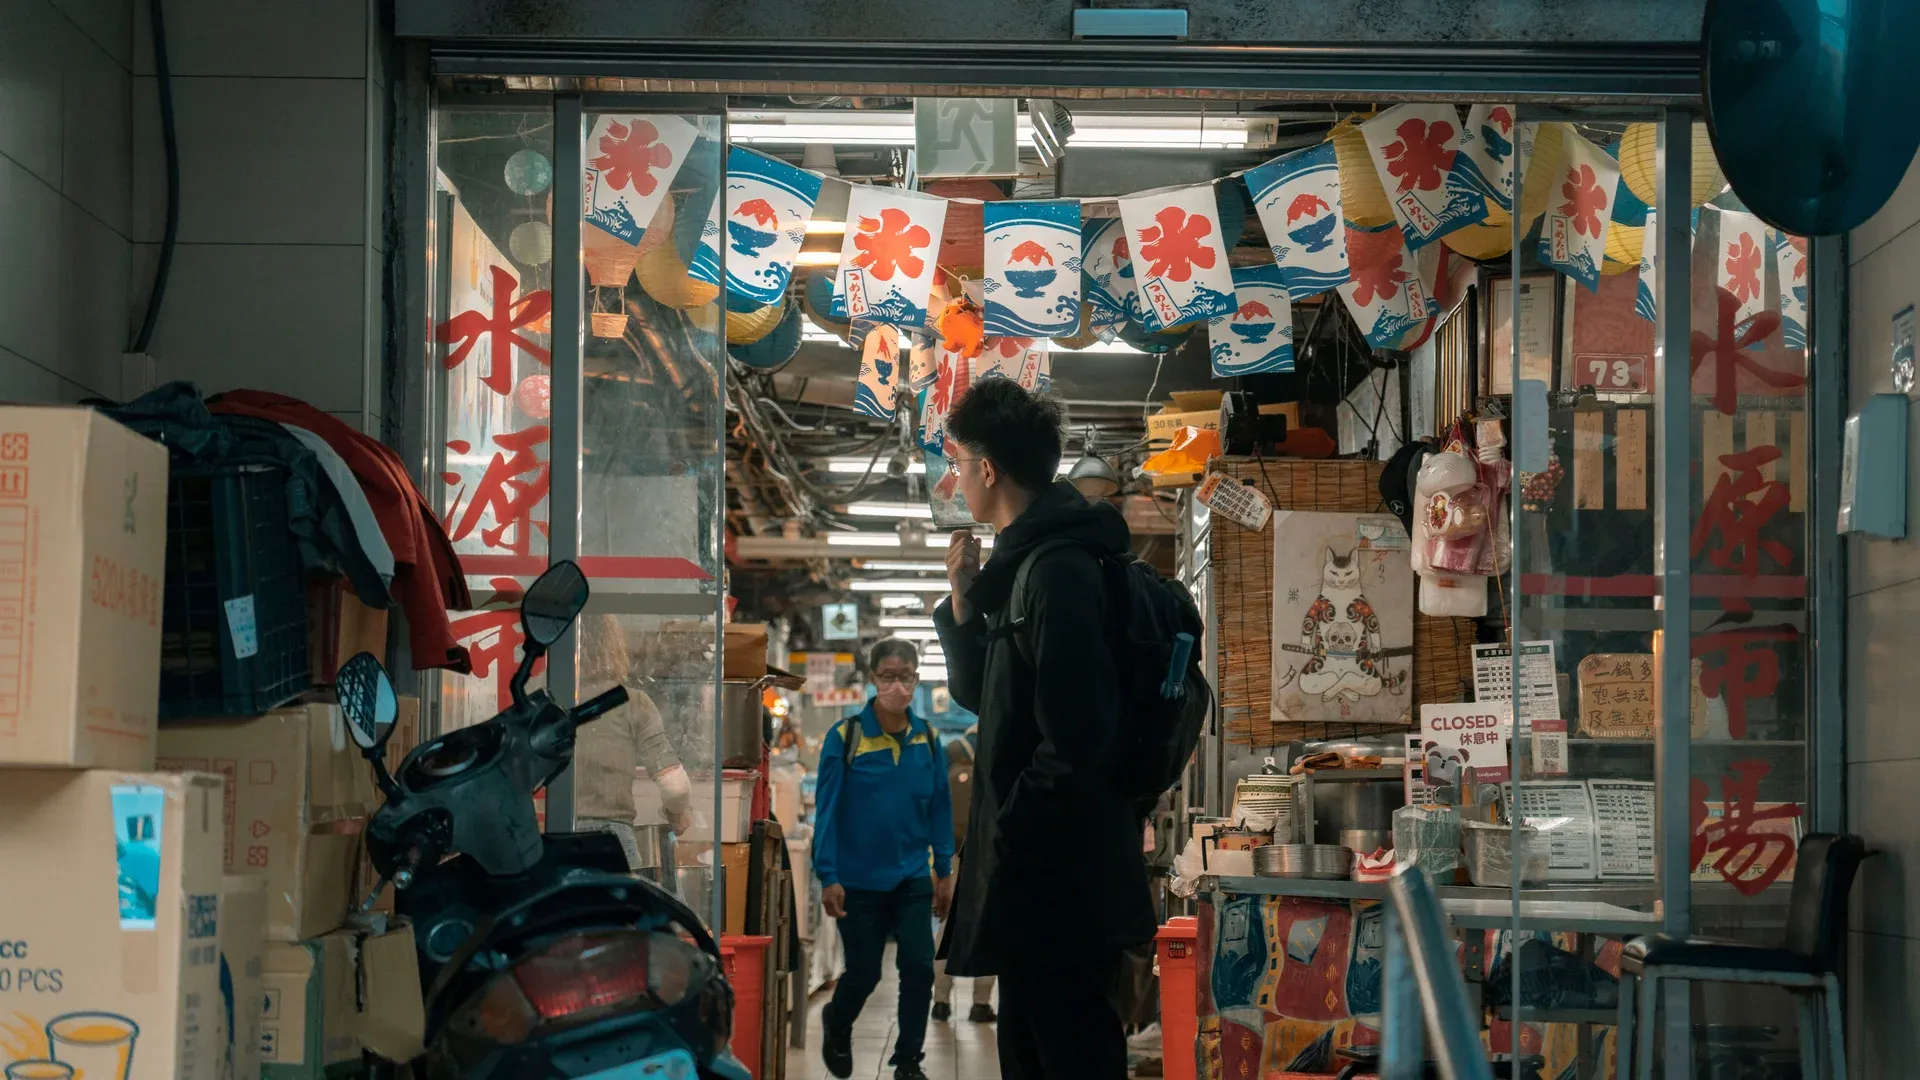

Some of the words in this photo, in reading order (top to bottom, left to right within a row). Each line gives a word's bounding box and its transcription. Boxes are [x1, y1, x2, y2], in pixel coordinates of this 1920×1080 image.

[1402, 198, 1434, 231] つめたい
[1554, 219, 1566, 260] つめたい
[849, 272, 865, 315] つめたい
[1148, 280, 1179, 324] つめたい
[1590, 360, 1630, 387] 73
[436, 264, 551, 835] 水源市
[1431, 715, 1498, 731] CLOSED
[1459, 731, 1499, 746] 休息中
[17, 968, 64, 993] PCS
